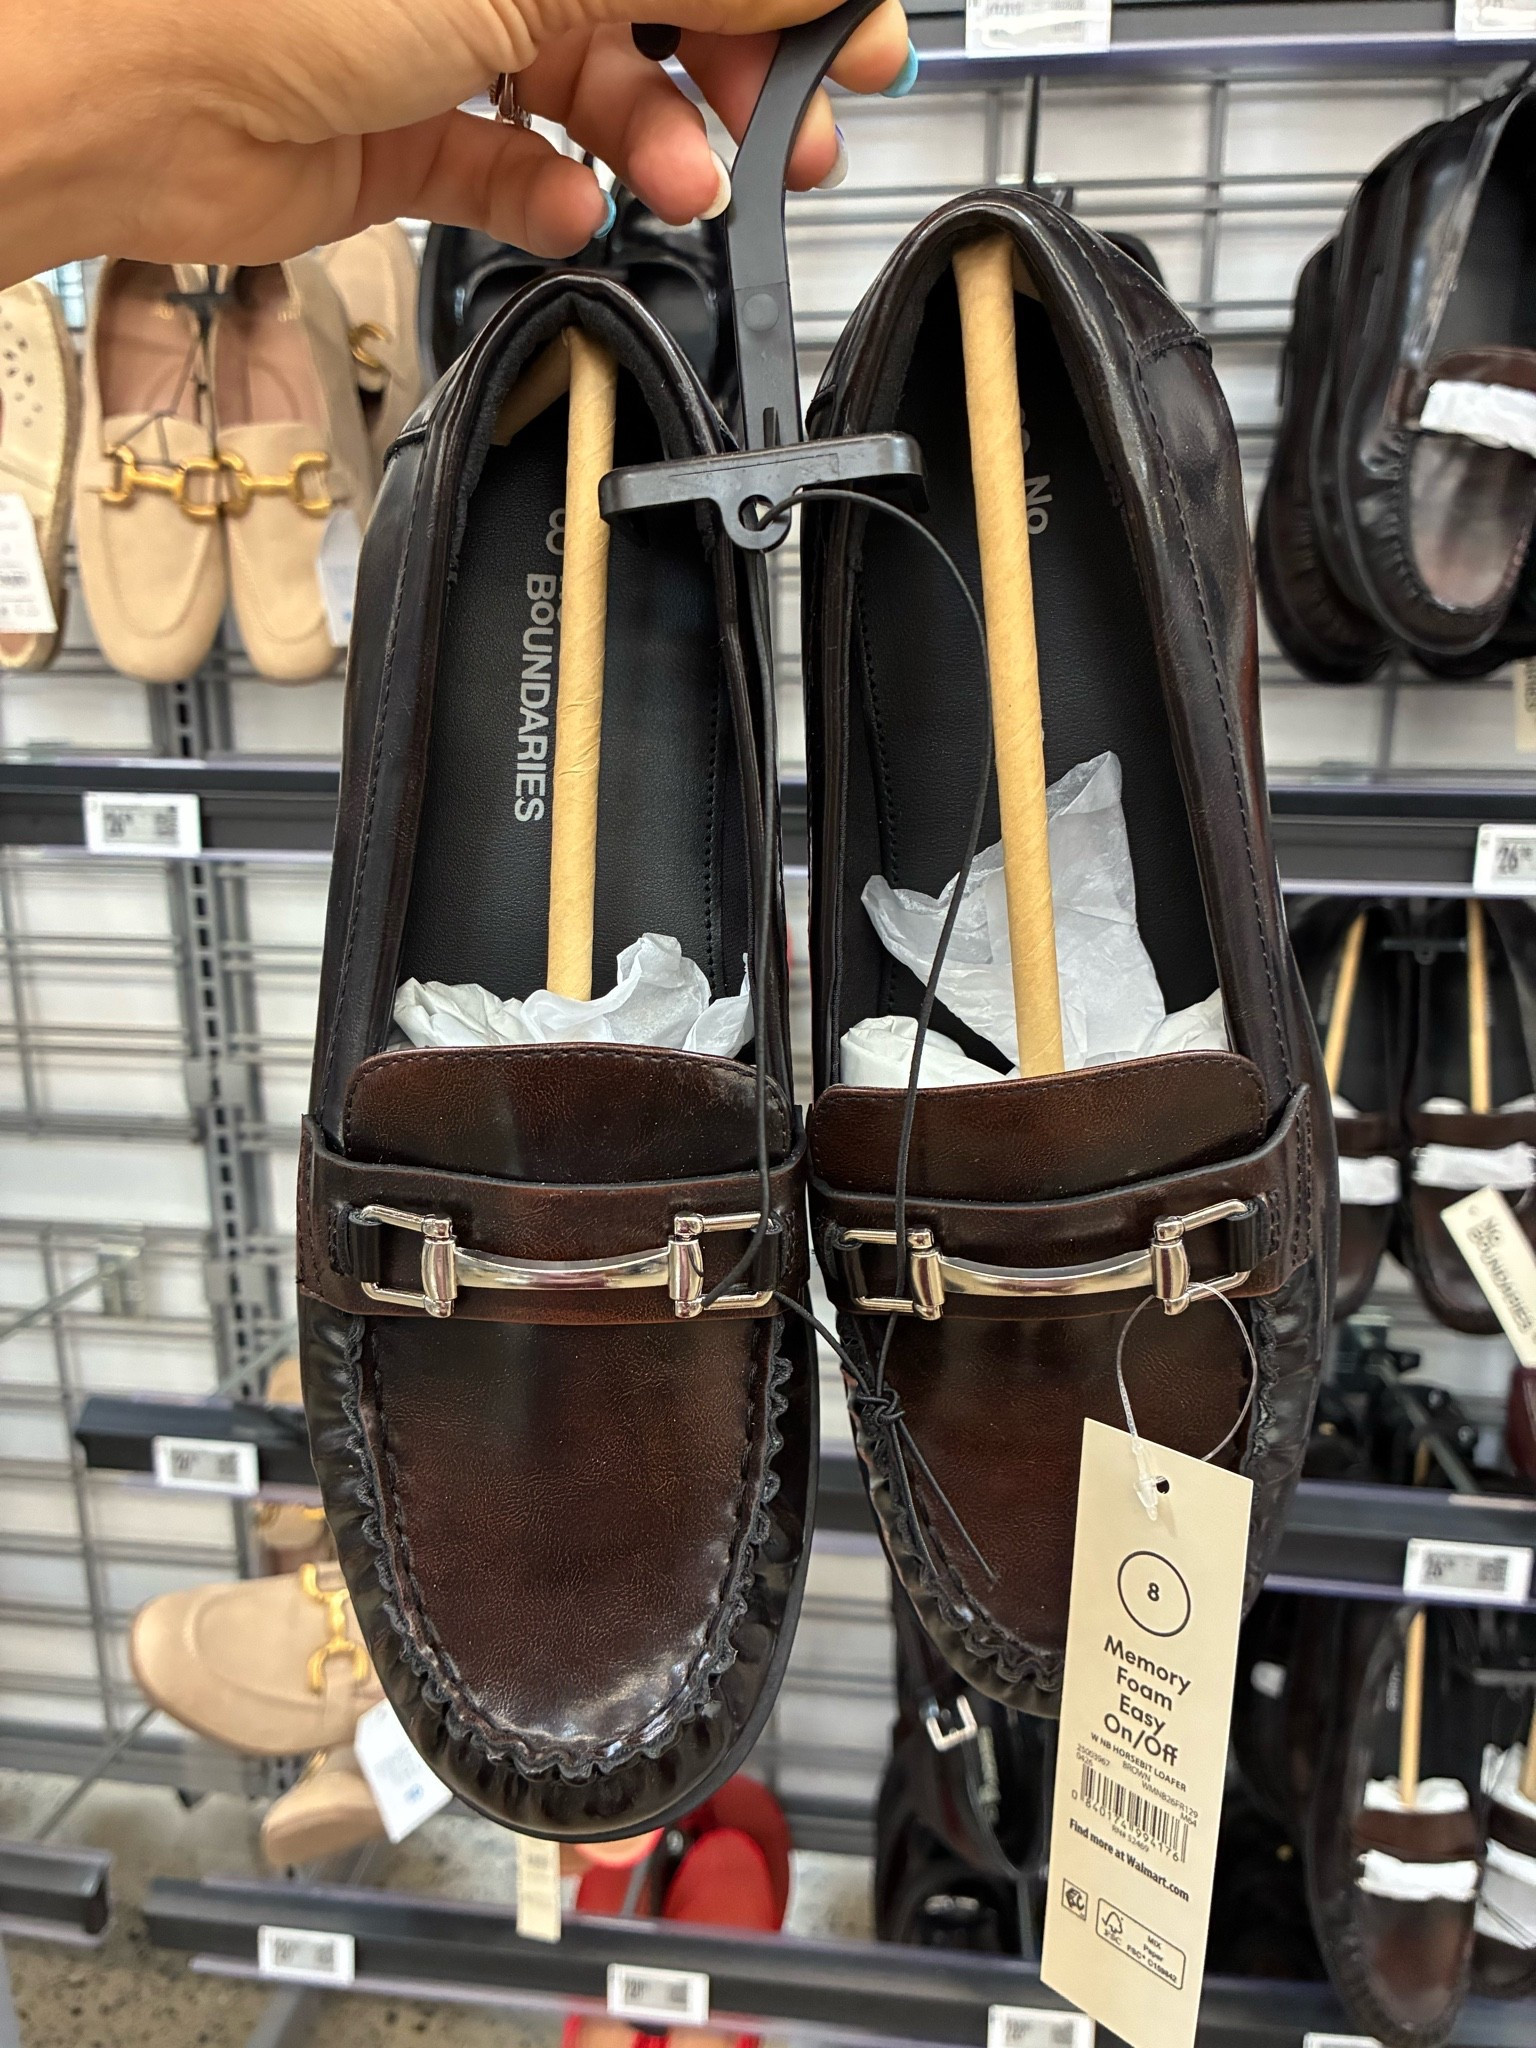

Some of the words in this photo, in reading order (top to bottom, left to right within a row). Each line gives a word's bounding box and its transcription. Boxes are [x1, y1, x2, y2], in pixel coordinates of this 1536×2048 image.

[513, 573, 558, 822] BOUNDARIES
[1147, 1582, 1160, 1602] 8
[1104, 1634, 1191, 1696] Memory
[1116, 1666, 1173, 1712] Foam
[1103, 1713, 1179, 1767] On/Off
[1119, 1693, 1166, 1736] Easy
[1091, 1732, 1099, 1742] W
[1100, 1738, 1112, 1750] NB
[1112, 1745, 1153, 1773] HORSEBIT
[1154, 1768, 1187, 1792] LOAFER
[1122, 1760, 1151, 1782] BROWN
[1069, 1818, 1089, 1839] Find
[1090, 1831, 1114, 1855] more
[1114, 1848, 1126, 1863] at
[1126, 1854, 1190, 1902] Walmart.com
